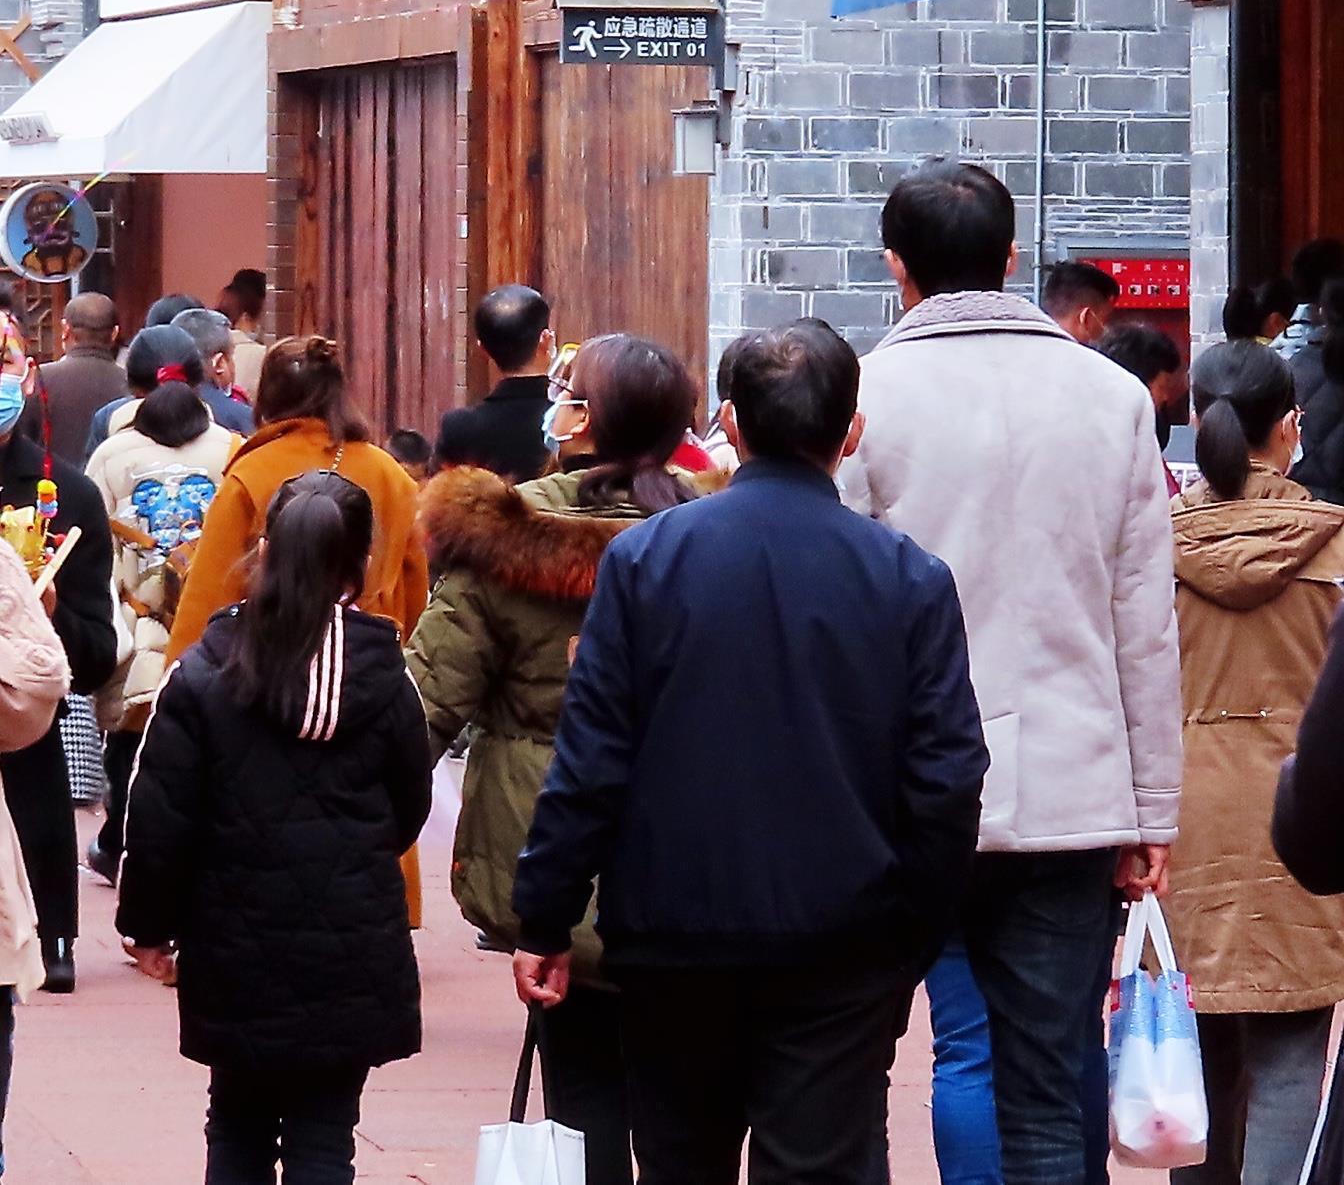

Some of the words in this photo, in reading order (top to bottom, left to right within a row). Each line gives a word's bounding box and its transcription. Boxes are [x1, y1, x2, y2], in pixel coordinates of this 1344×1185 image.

[605, 16, 708, 39] 应急疏散通道
[637, 42, 681, 57] EXIT
[686, 42, 706, 57] 01
